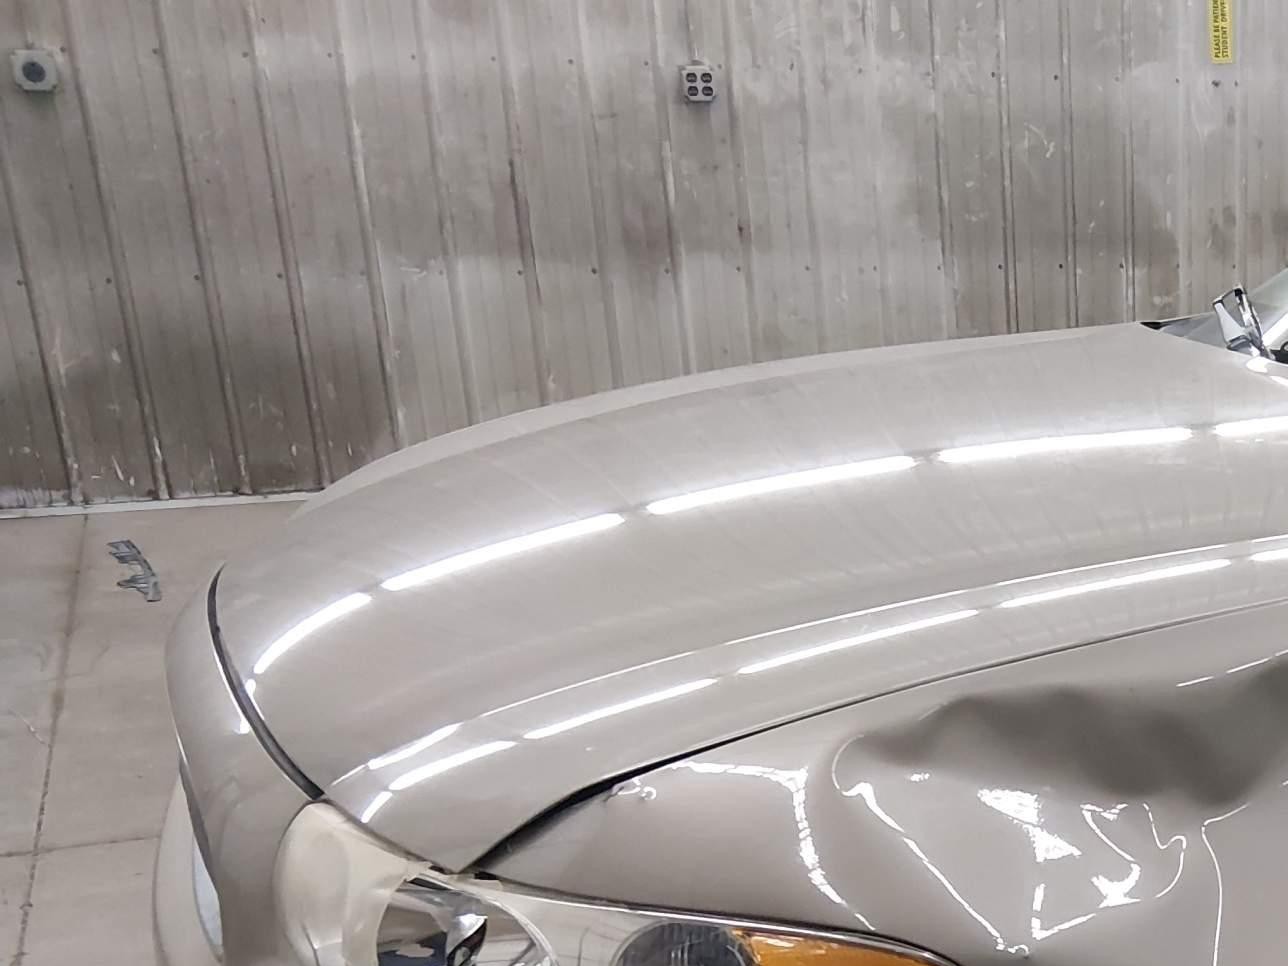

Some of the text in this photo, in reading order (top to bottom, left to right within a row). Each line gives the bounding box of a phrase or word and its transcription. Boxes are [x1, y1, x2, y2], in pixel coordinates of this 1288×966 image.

[1213, 24, 1220, 33] BE
[1213, 34, 1221, 58] PLEASE
[1220, 26, 1229, 58] STUDENT
